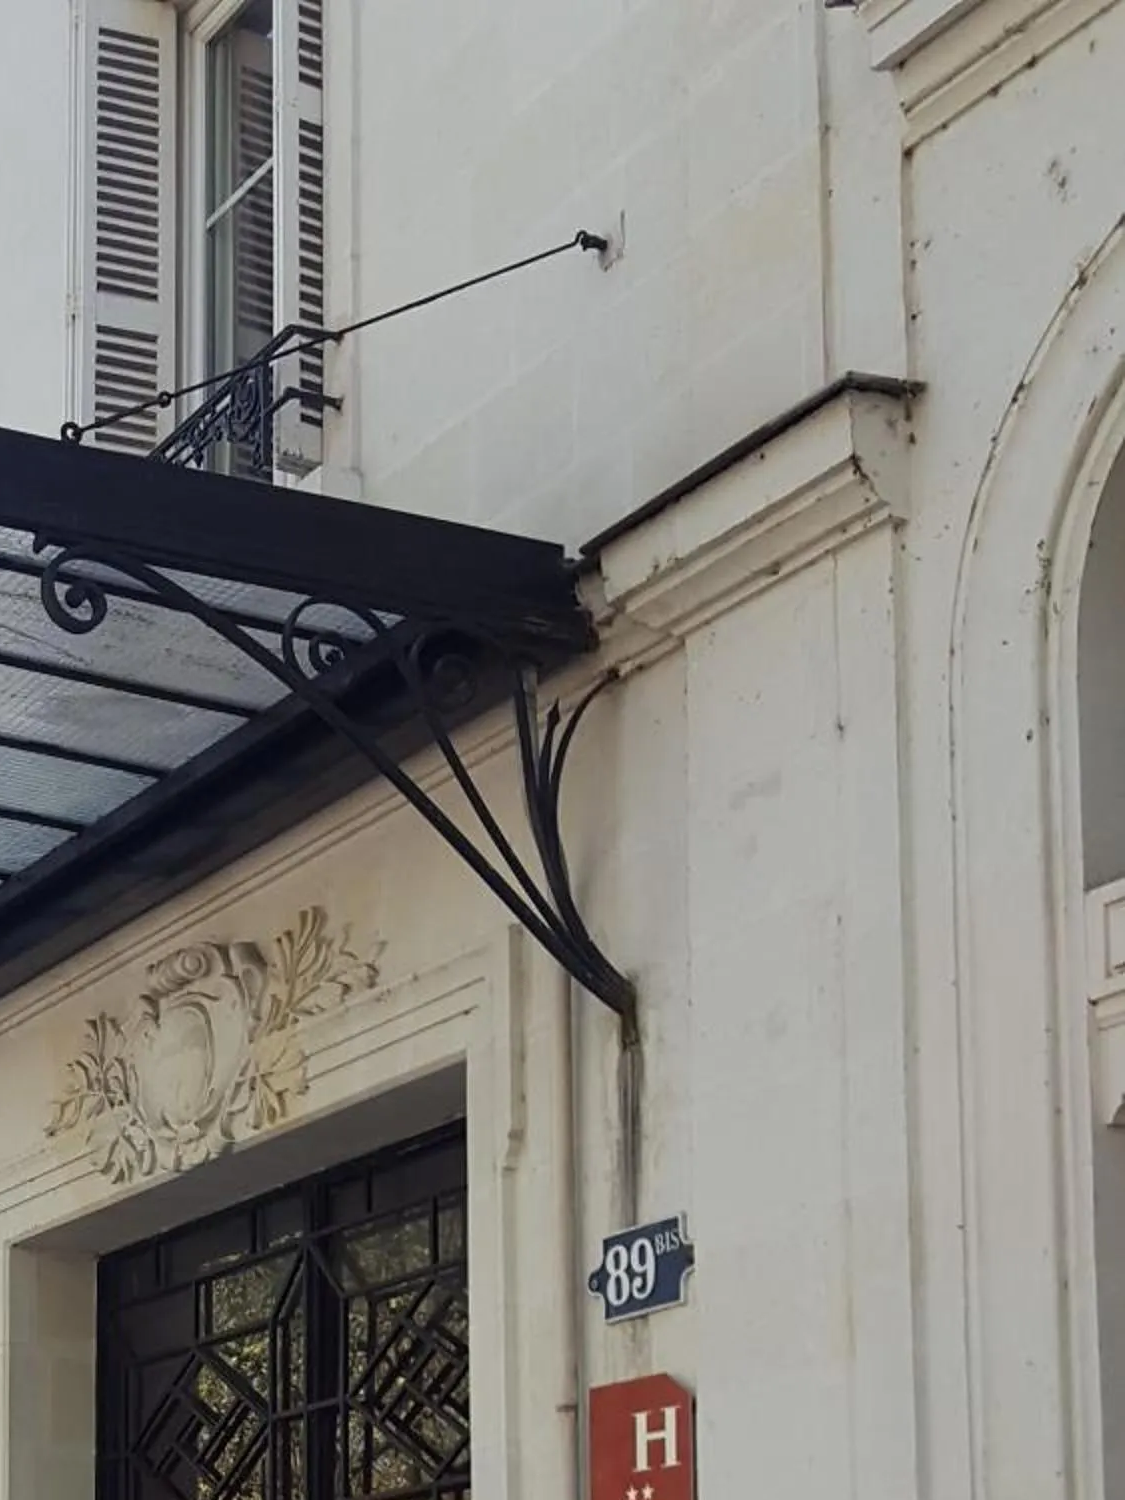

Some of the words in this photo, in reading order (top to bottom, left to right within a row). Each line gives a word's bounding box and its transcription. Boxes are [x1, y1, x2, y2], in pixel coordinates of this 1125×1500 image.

[605, 1237, 656, 1307] 89
[654, 1230, 680, 1256] BIS
[631, 1404, 682, 1472] H
